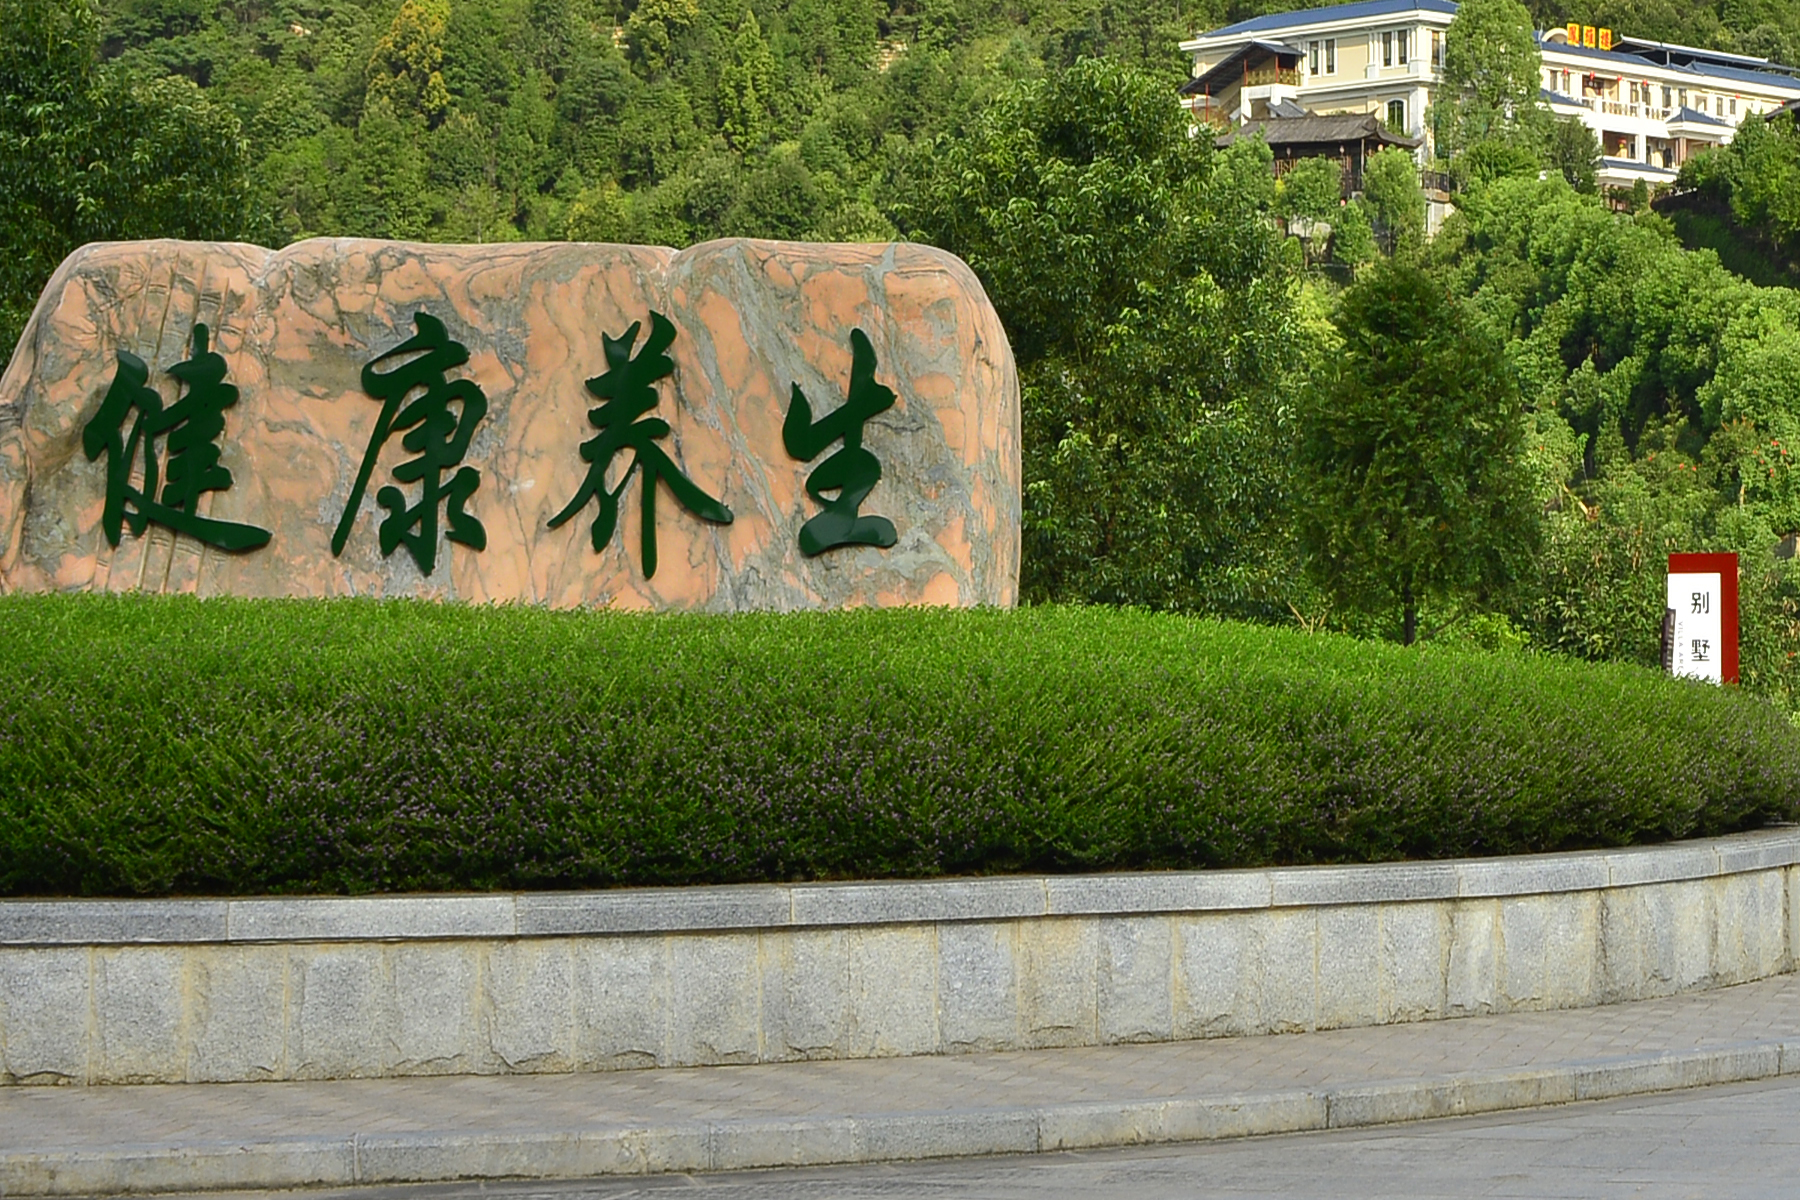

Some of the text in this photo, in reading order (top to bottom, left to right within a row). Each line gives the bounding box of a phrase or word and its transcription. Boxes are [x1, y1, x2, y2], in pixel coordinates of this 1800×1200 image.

[83, 310, 900, 580] 健康养生
[1691, 591, 1710, 662] 别墅
